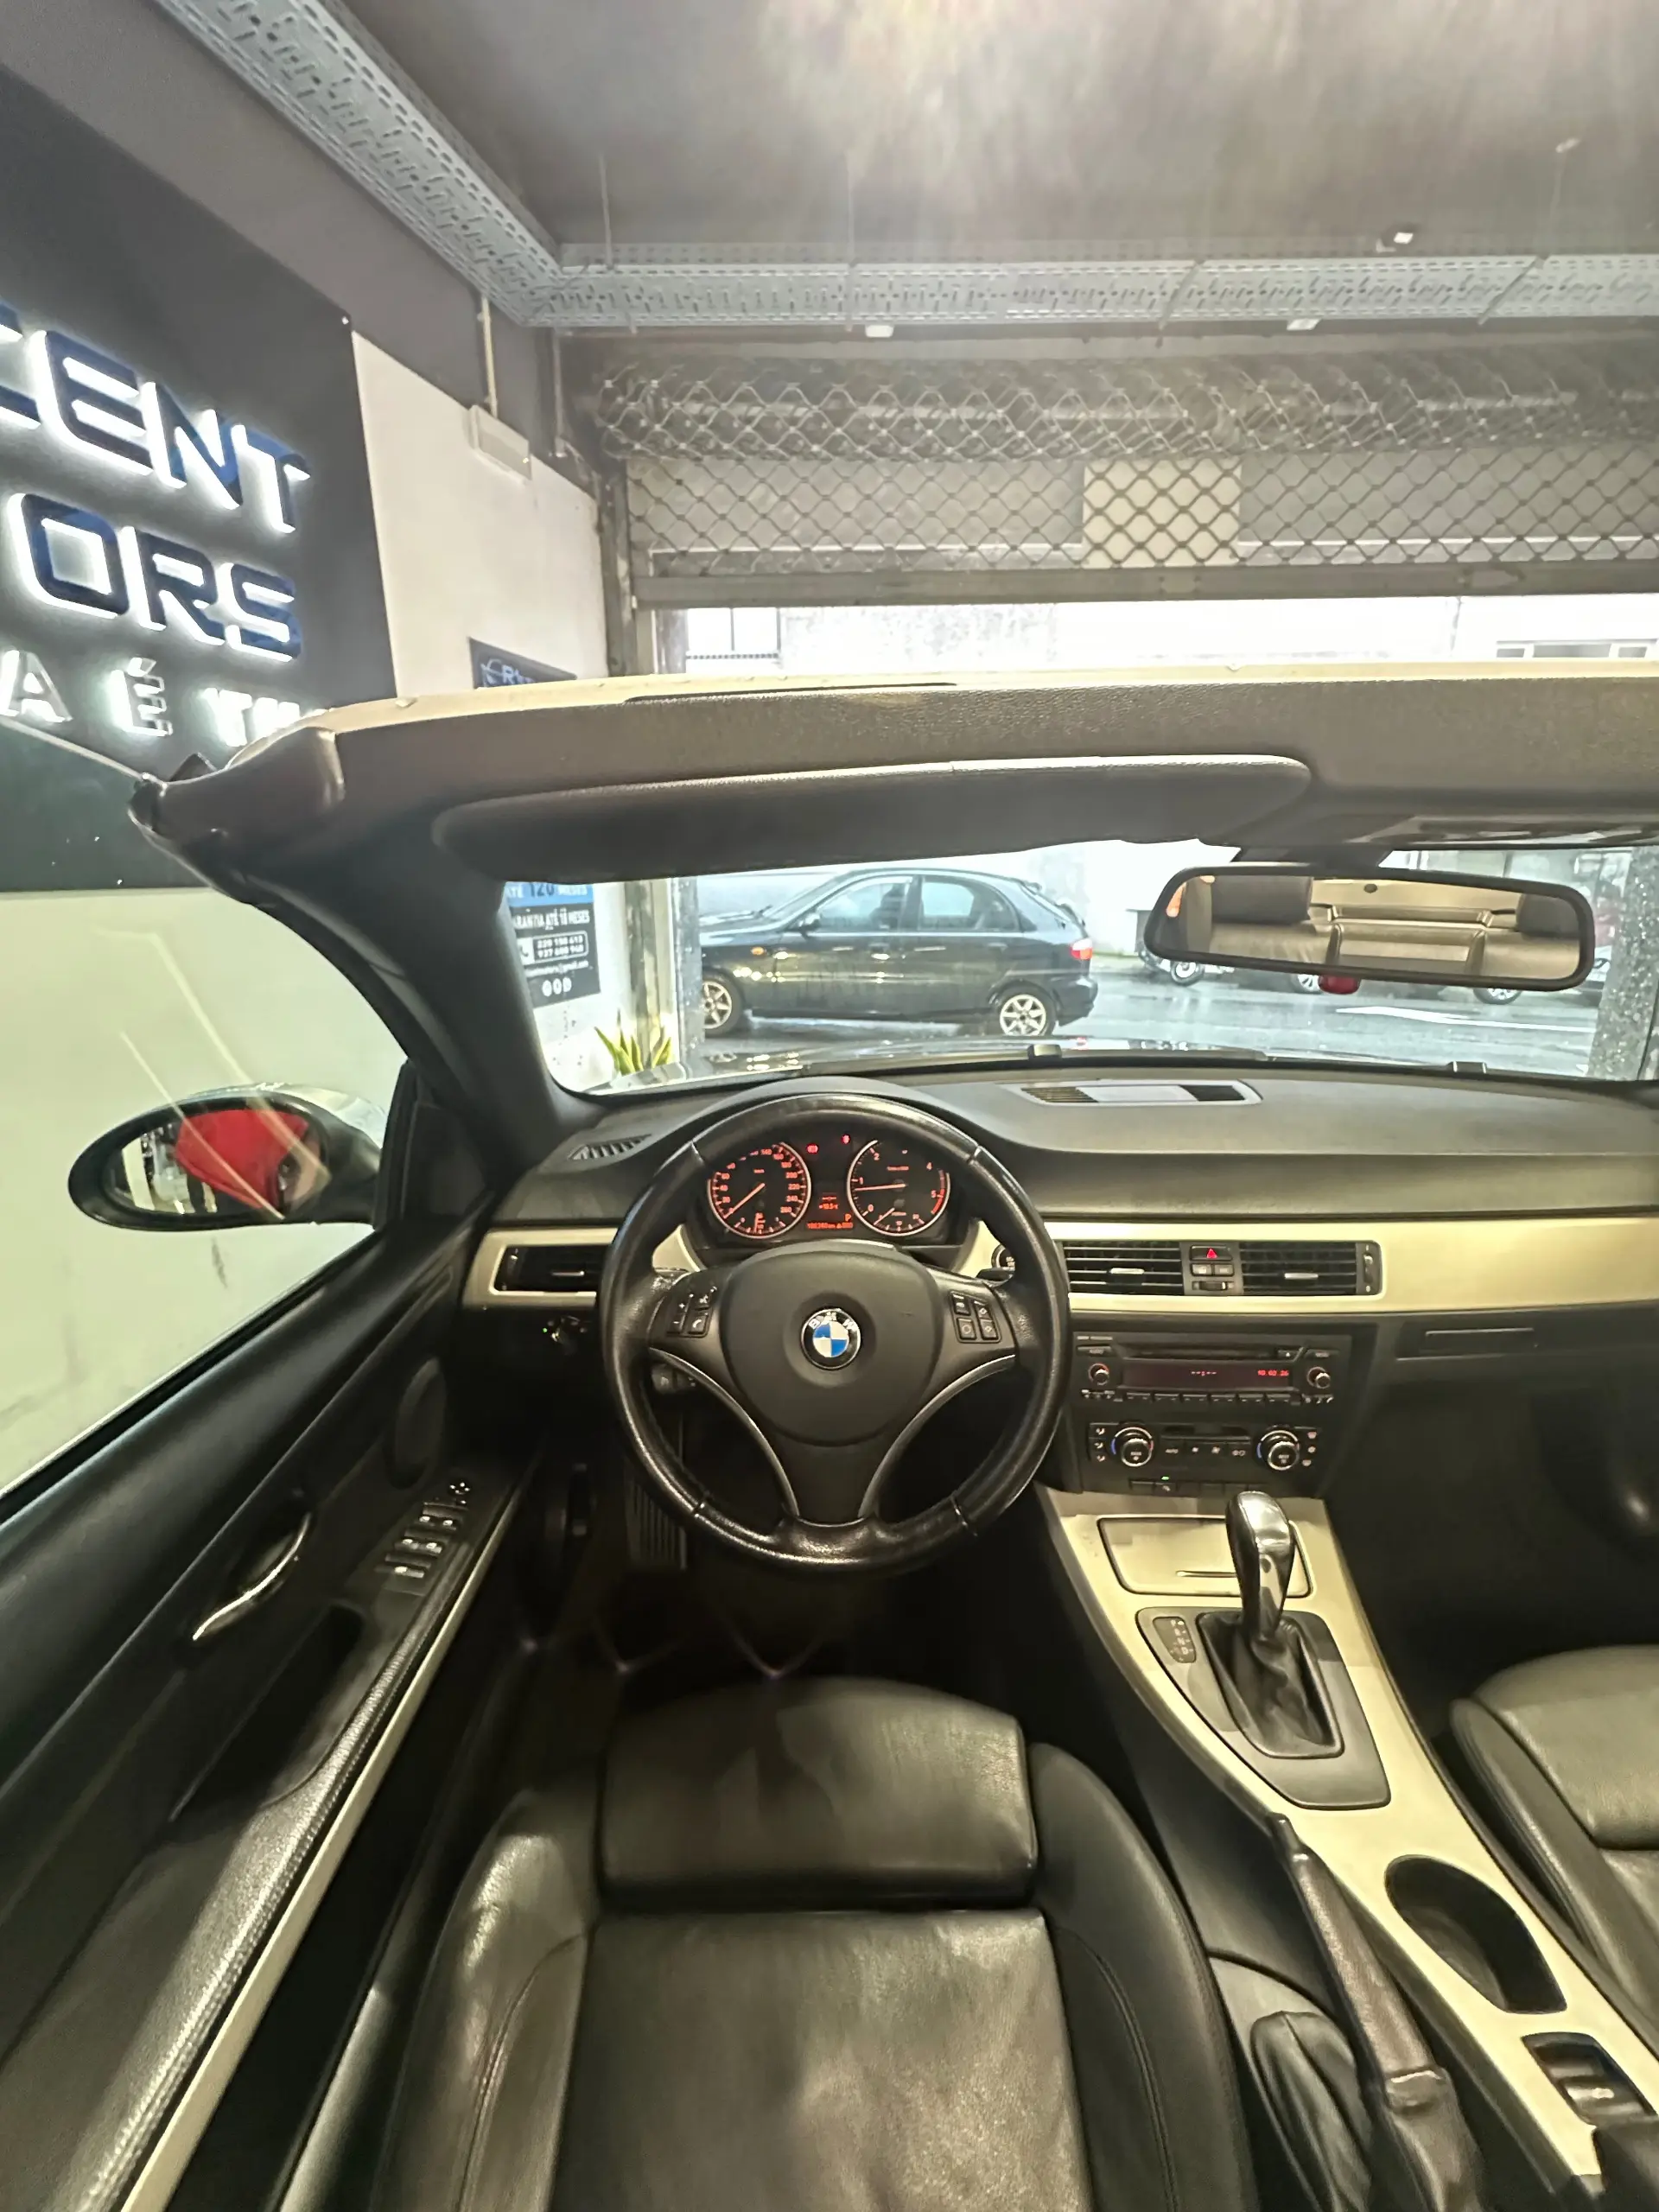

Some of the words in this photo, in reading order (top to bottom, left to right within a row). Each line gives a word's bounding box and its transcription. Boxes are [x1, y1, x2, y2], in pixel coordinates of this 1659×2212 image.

[6, 493, 301, 663] ORS
[108, 657, 173, 736] É
[808, 1311, 859, 1332] BMW
